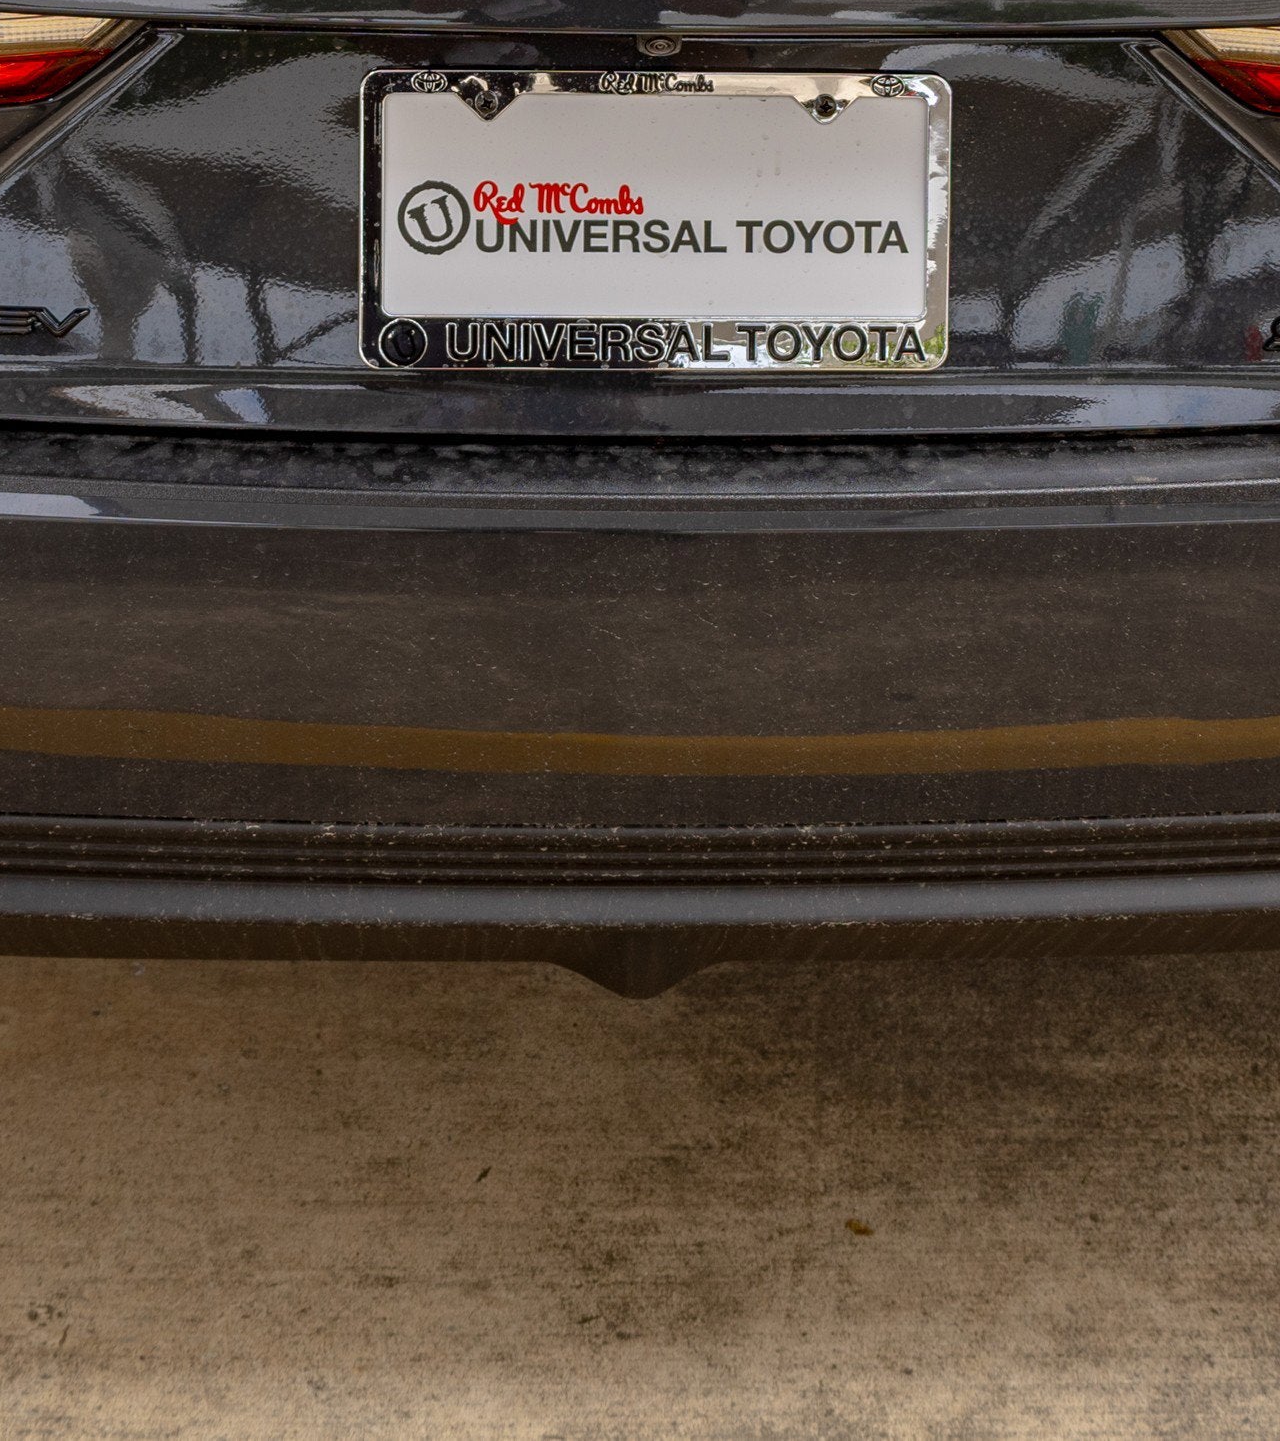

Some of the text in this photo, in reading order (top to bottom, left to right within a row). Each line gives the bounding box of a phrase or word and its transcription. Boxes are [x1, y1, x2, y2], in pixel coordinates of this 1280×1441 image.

[600, 70, 715, 95] Red McCombs
[473, 180, 644, 225] Red McCombs
[475, 219, 909, 254] UNIVERSAL TOYOTA
[445, 322, 928, 362] UNIVERSAL TOYOTA
